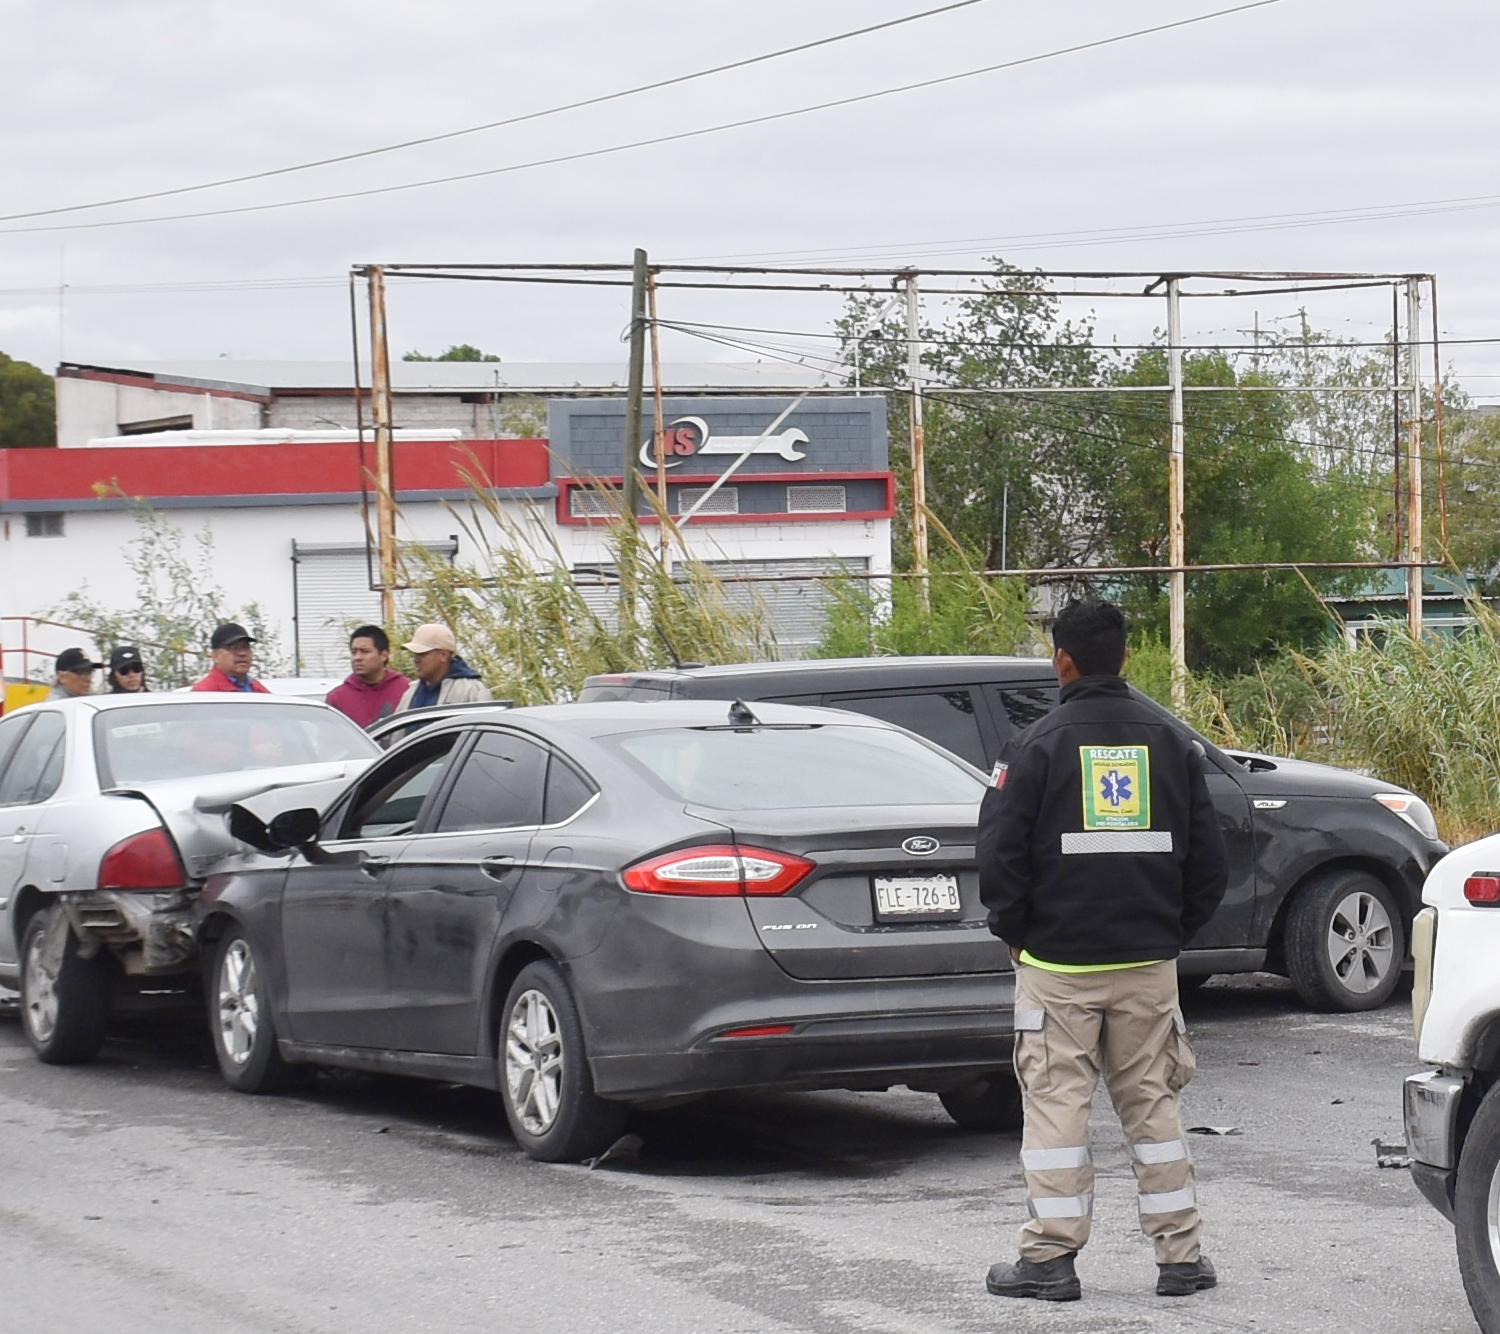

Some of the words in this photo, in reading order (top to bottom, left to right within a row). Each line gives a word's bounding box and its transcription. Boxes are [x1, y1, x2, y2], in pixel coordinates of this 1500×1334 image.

[1089, 749, 1139, 759] RESCATE
[877, 885, 957, 908] FLE-726-B
[762, 922, 818, 931] FUSON
